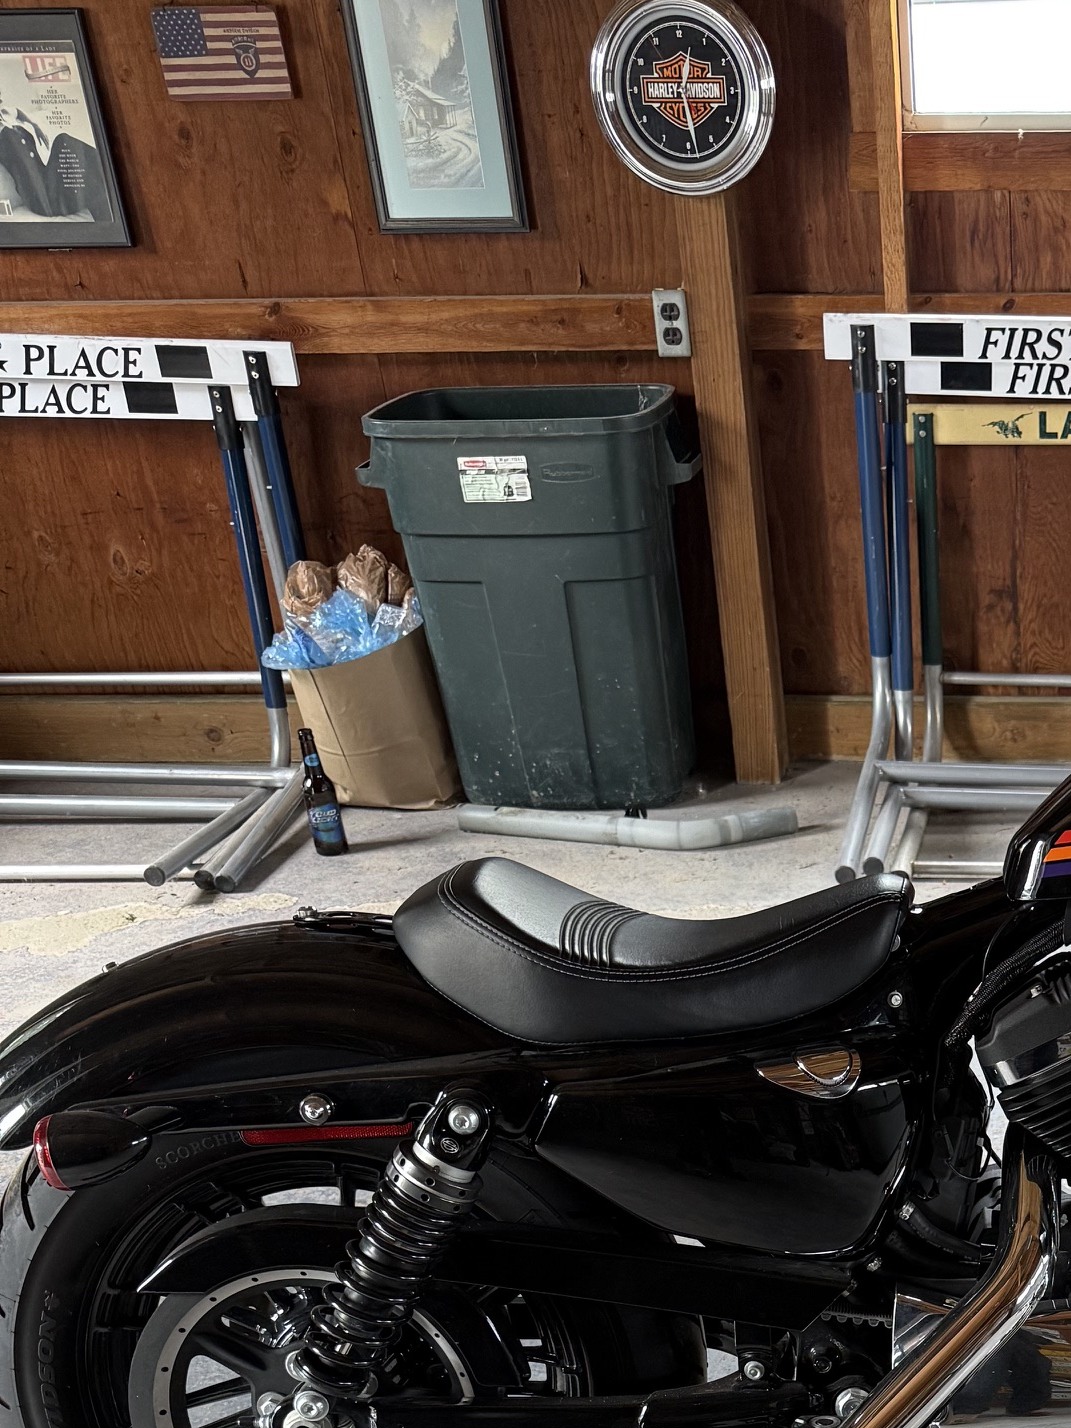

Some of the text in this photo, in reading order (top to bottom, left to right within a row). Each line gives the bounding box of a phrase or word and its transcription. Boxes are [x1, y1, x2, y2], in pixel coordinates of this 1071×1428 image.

[675, 29, 683, 38] 12
[652, 37, 659, 46] 11
[702, 37, 707, 46] 1
[637, 58, 645, 66] 10
[721, 58, 726, 66] 2
[633, 86, 638, 94] 9
[729, 86, 735, 94] 3
[642, 115, 648, 123] 8
[661, 134, 666, 142] 7
[708, 135, 714, 143] 5
[686, 142, 691, 150] 6
[22, 344, 143, 378] PLACE
[0, 382, 111, 414] PLACE
